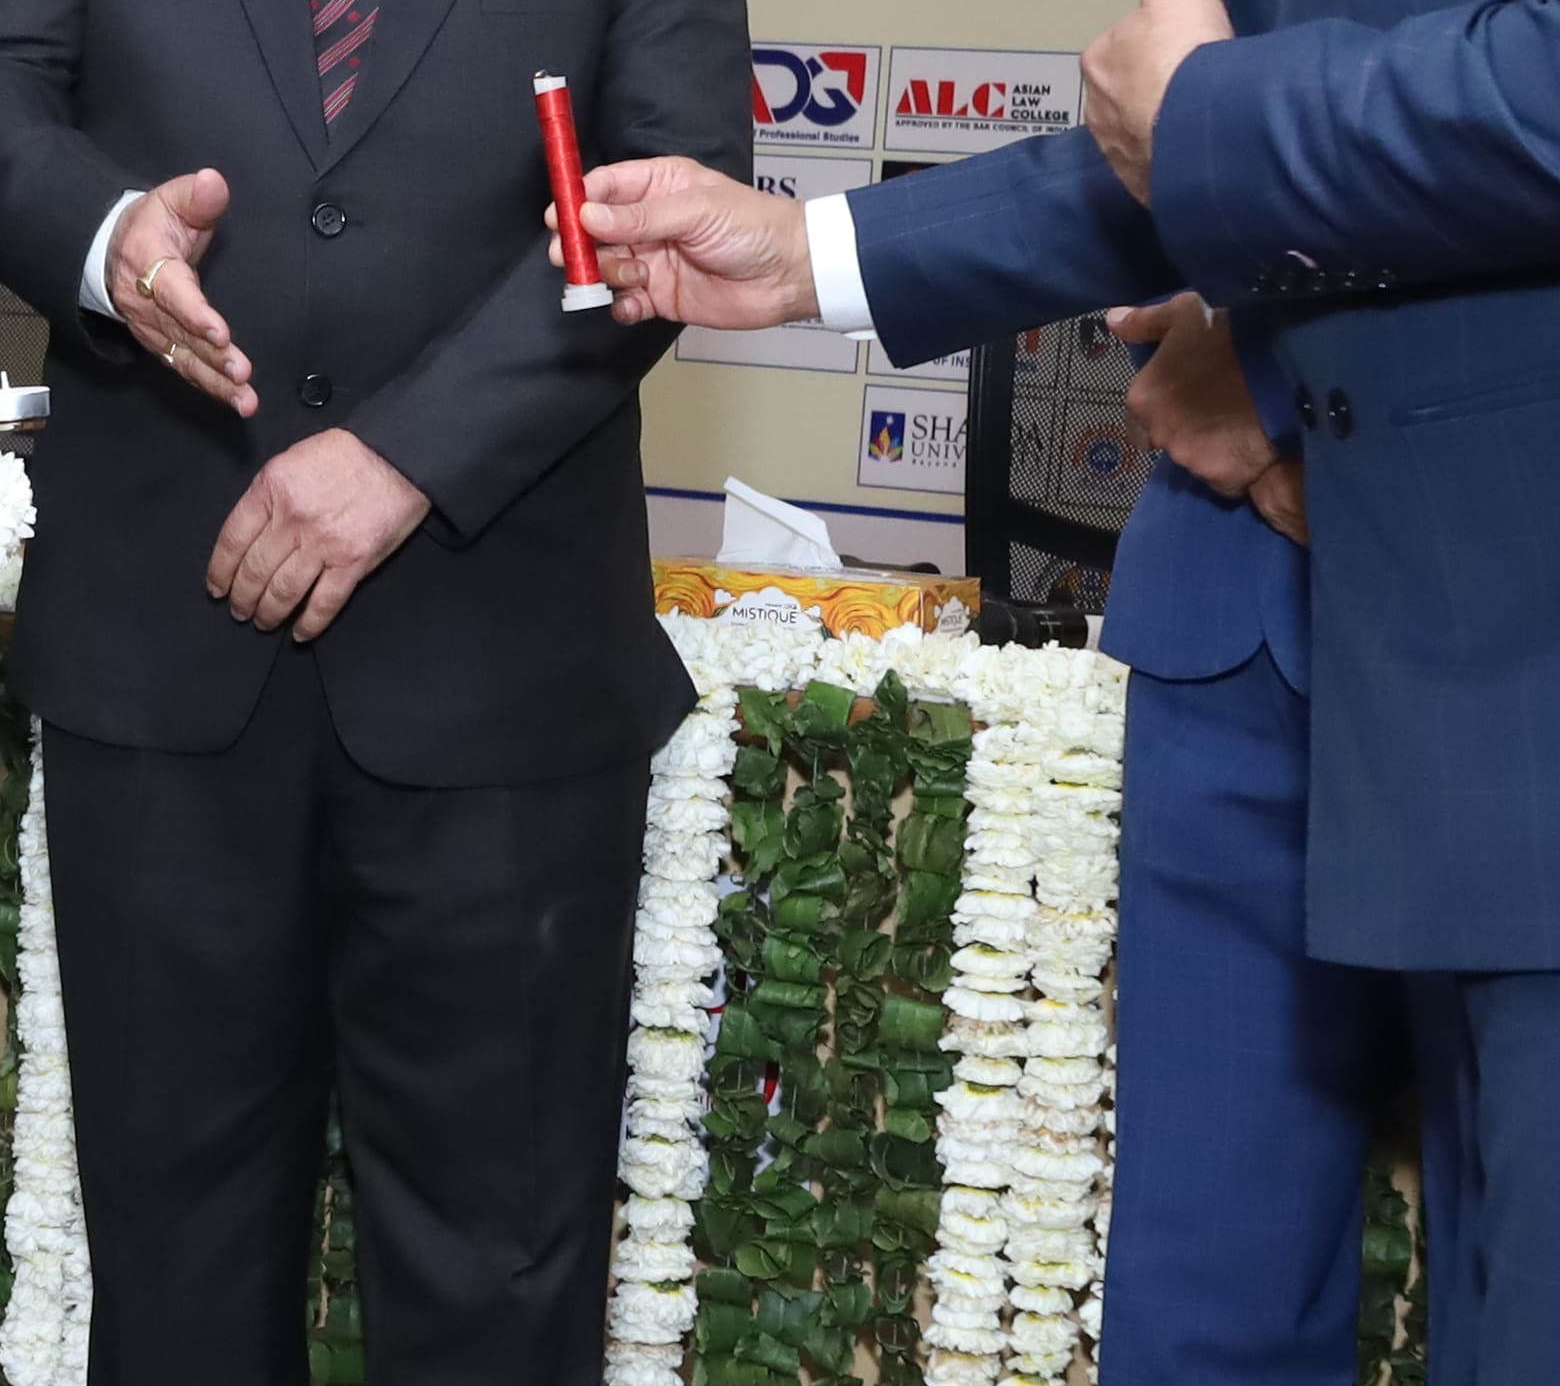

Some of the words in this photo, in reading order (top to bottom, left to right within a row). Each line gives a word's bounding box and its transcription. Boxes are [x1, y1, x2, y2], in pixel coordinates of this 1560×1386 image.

[1013, 84, 1051, 95] ASIAN
[896, 79, 1007, 118] ALC
[1011, 97, 1041, 108] LAW
[1010, 109, 1070, 122] COLLEGE
[895, 119, 939, 129] APPROVED
[942, 121, 952, 129] BY
[955, 122, 970, 131] THE
[973, 122, 989, 131] BAR
[993, 123, 1028, 133] COUNCIL
[759, 130, 820, 141] Professional
[823, 133, 860, 143] Studies
[733, 607, 797, 624] MISTIQUE
